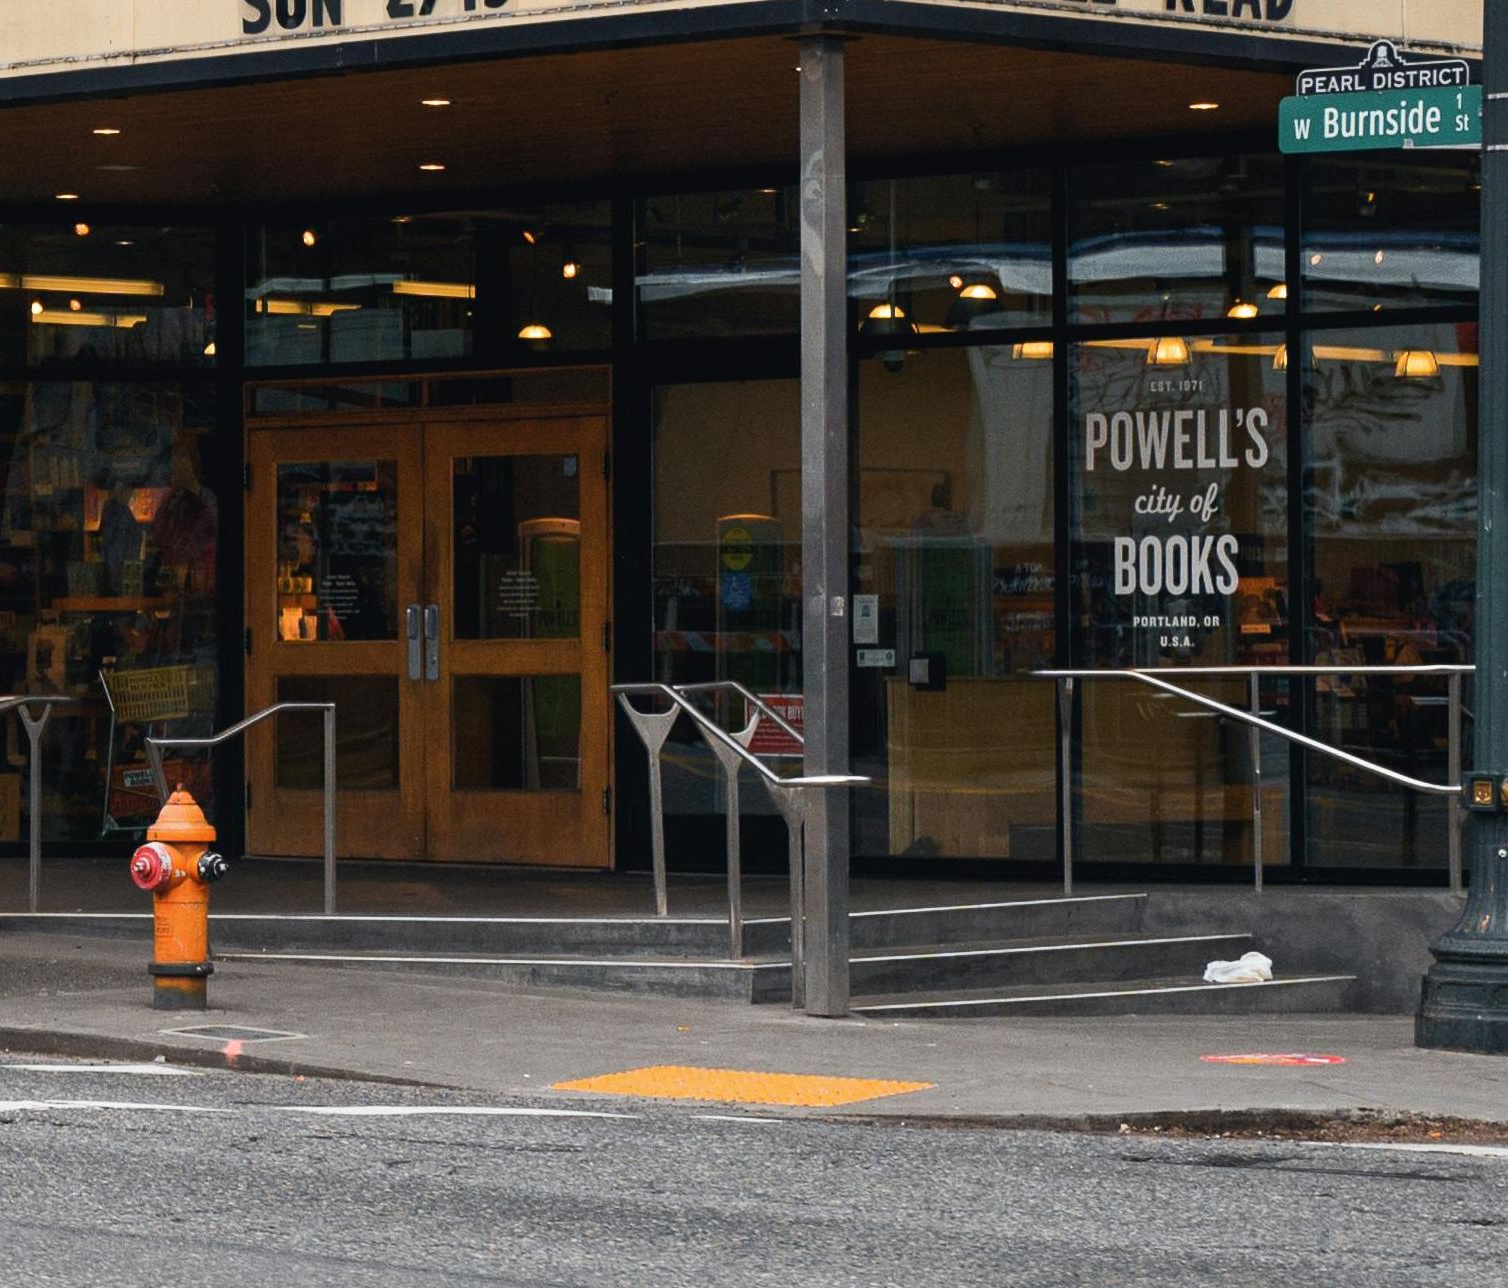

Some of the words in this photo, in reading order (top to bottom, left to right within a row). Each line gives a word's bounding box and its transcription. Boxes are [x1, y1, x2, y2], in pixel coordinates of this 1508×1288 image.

[1301, 73, 1364, 95] PEARL
[1373, 66, 1465, 90] DISTRICT
[1293, 117, 1311, 140] W
[1323, 99, 1441, 139] Burnside
[1455, 113, 1470, 132] St
[1150, 380, 1175, 392] EST.
[1179, 379, 1203, 392] 1971
[1085, 407, 1269, 472] POWELL'S
[1134, 484, 1184, 523] city
[1189, 482, 1219, 523] of
[1114, 534, 1240, 596] BOOKS
[1133, 615, 1201, 629] PORTLAND,
[1204, 615, 1221, 627] OR
[1159, 636, 1196, 648] U.S.A.
